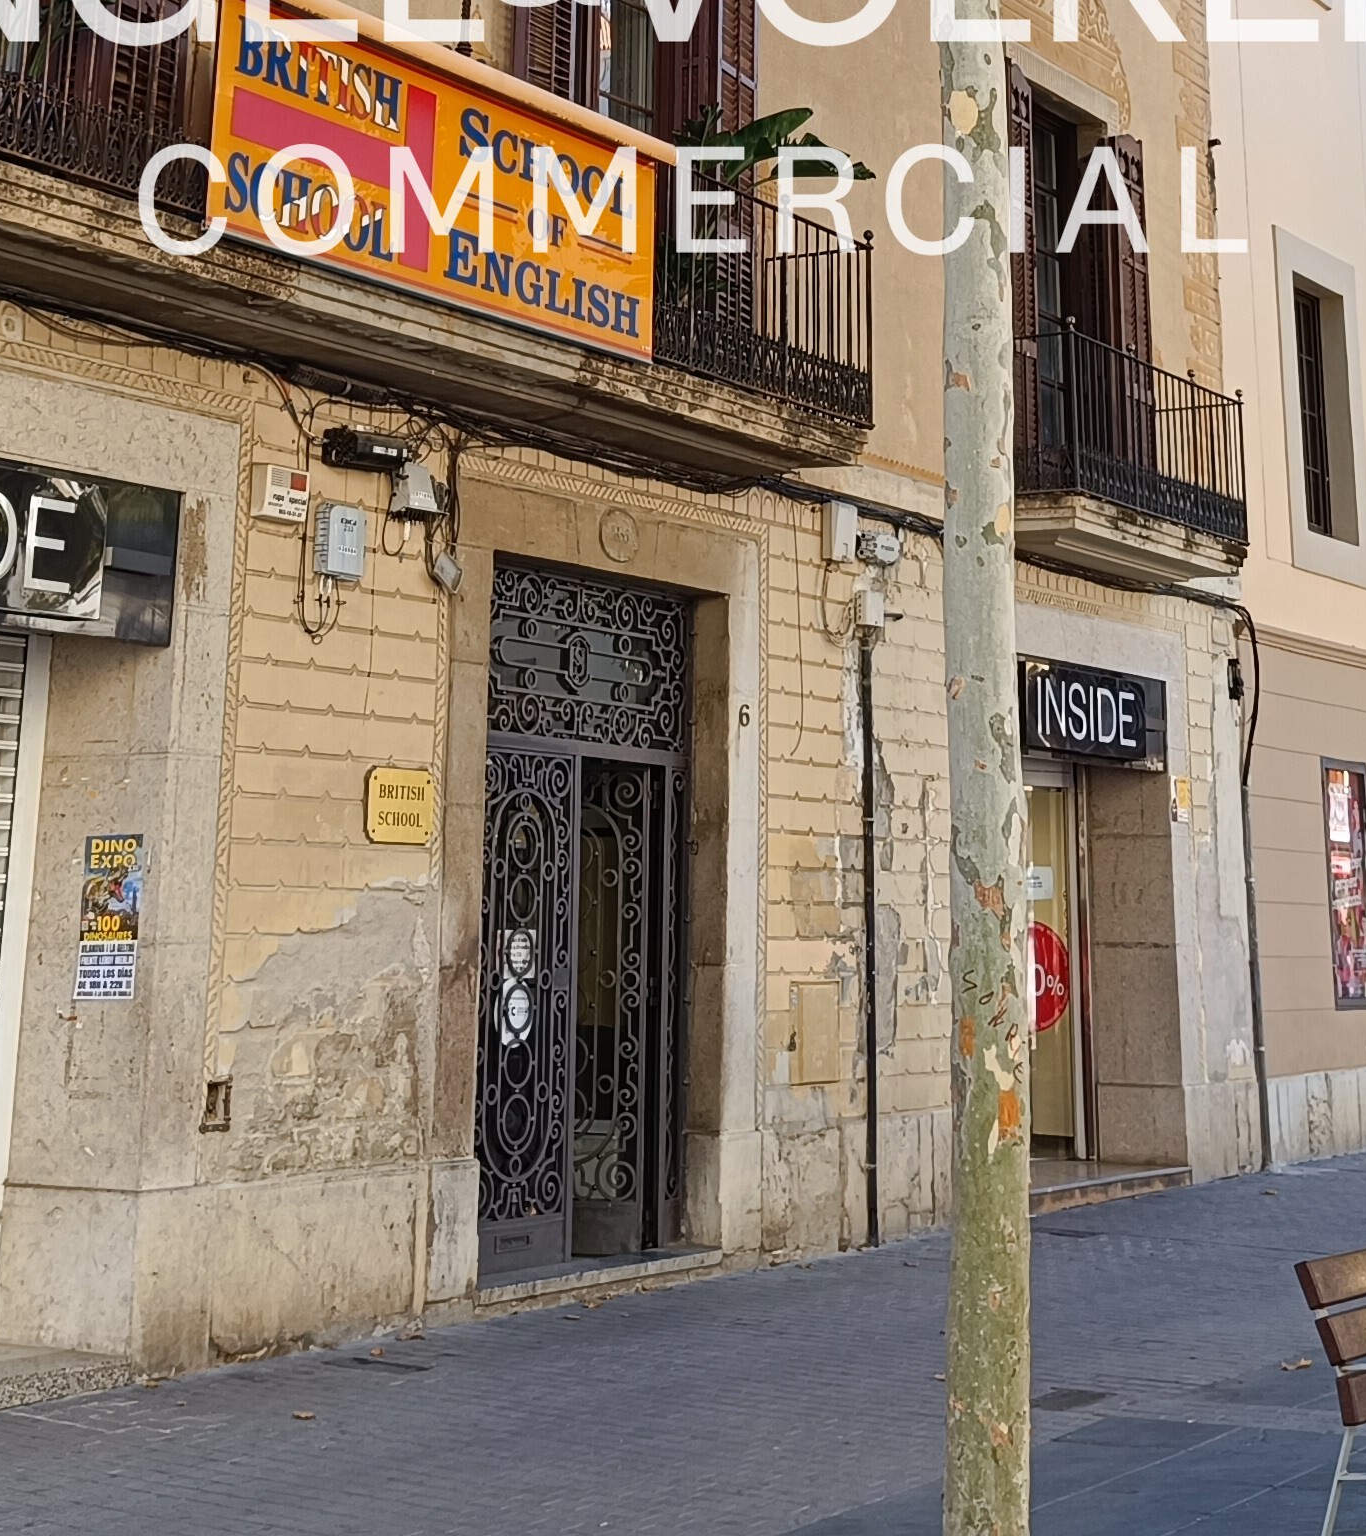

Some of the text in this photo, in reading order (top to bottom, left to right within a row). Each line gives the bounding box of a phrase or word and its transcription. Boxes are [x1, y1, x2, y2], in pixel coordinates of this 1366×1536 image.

[236, 15, 402, 133] BRITISH
[458, 107, 633, 219] SCHOOL
[224, 152, 394, 263] SCHOOL
[528, 205, 567, 248] OF
[443, 227, 640, 338] ENGLISH
[738, 703, 750, 728] 6
[1035, 675, 1138, 749] INSIDE
[378, 783, 425, 801] BRITISH
[377, 810, 423, 828] SCHOOL
[91, 838, 137, 854] DINO
[90, 853, 136, 869] EXPO
[96, 915, 121, 931] 100
[79, 969, 101, 979] TODOS
[102, 968, 116, 978] LOS
